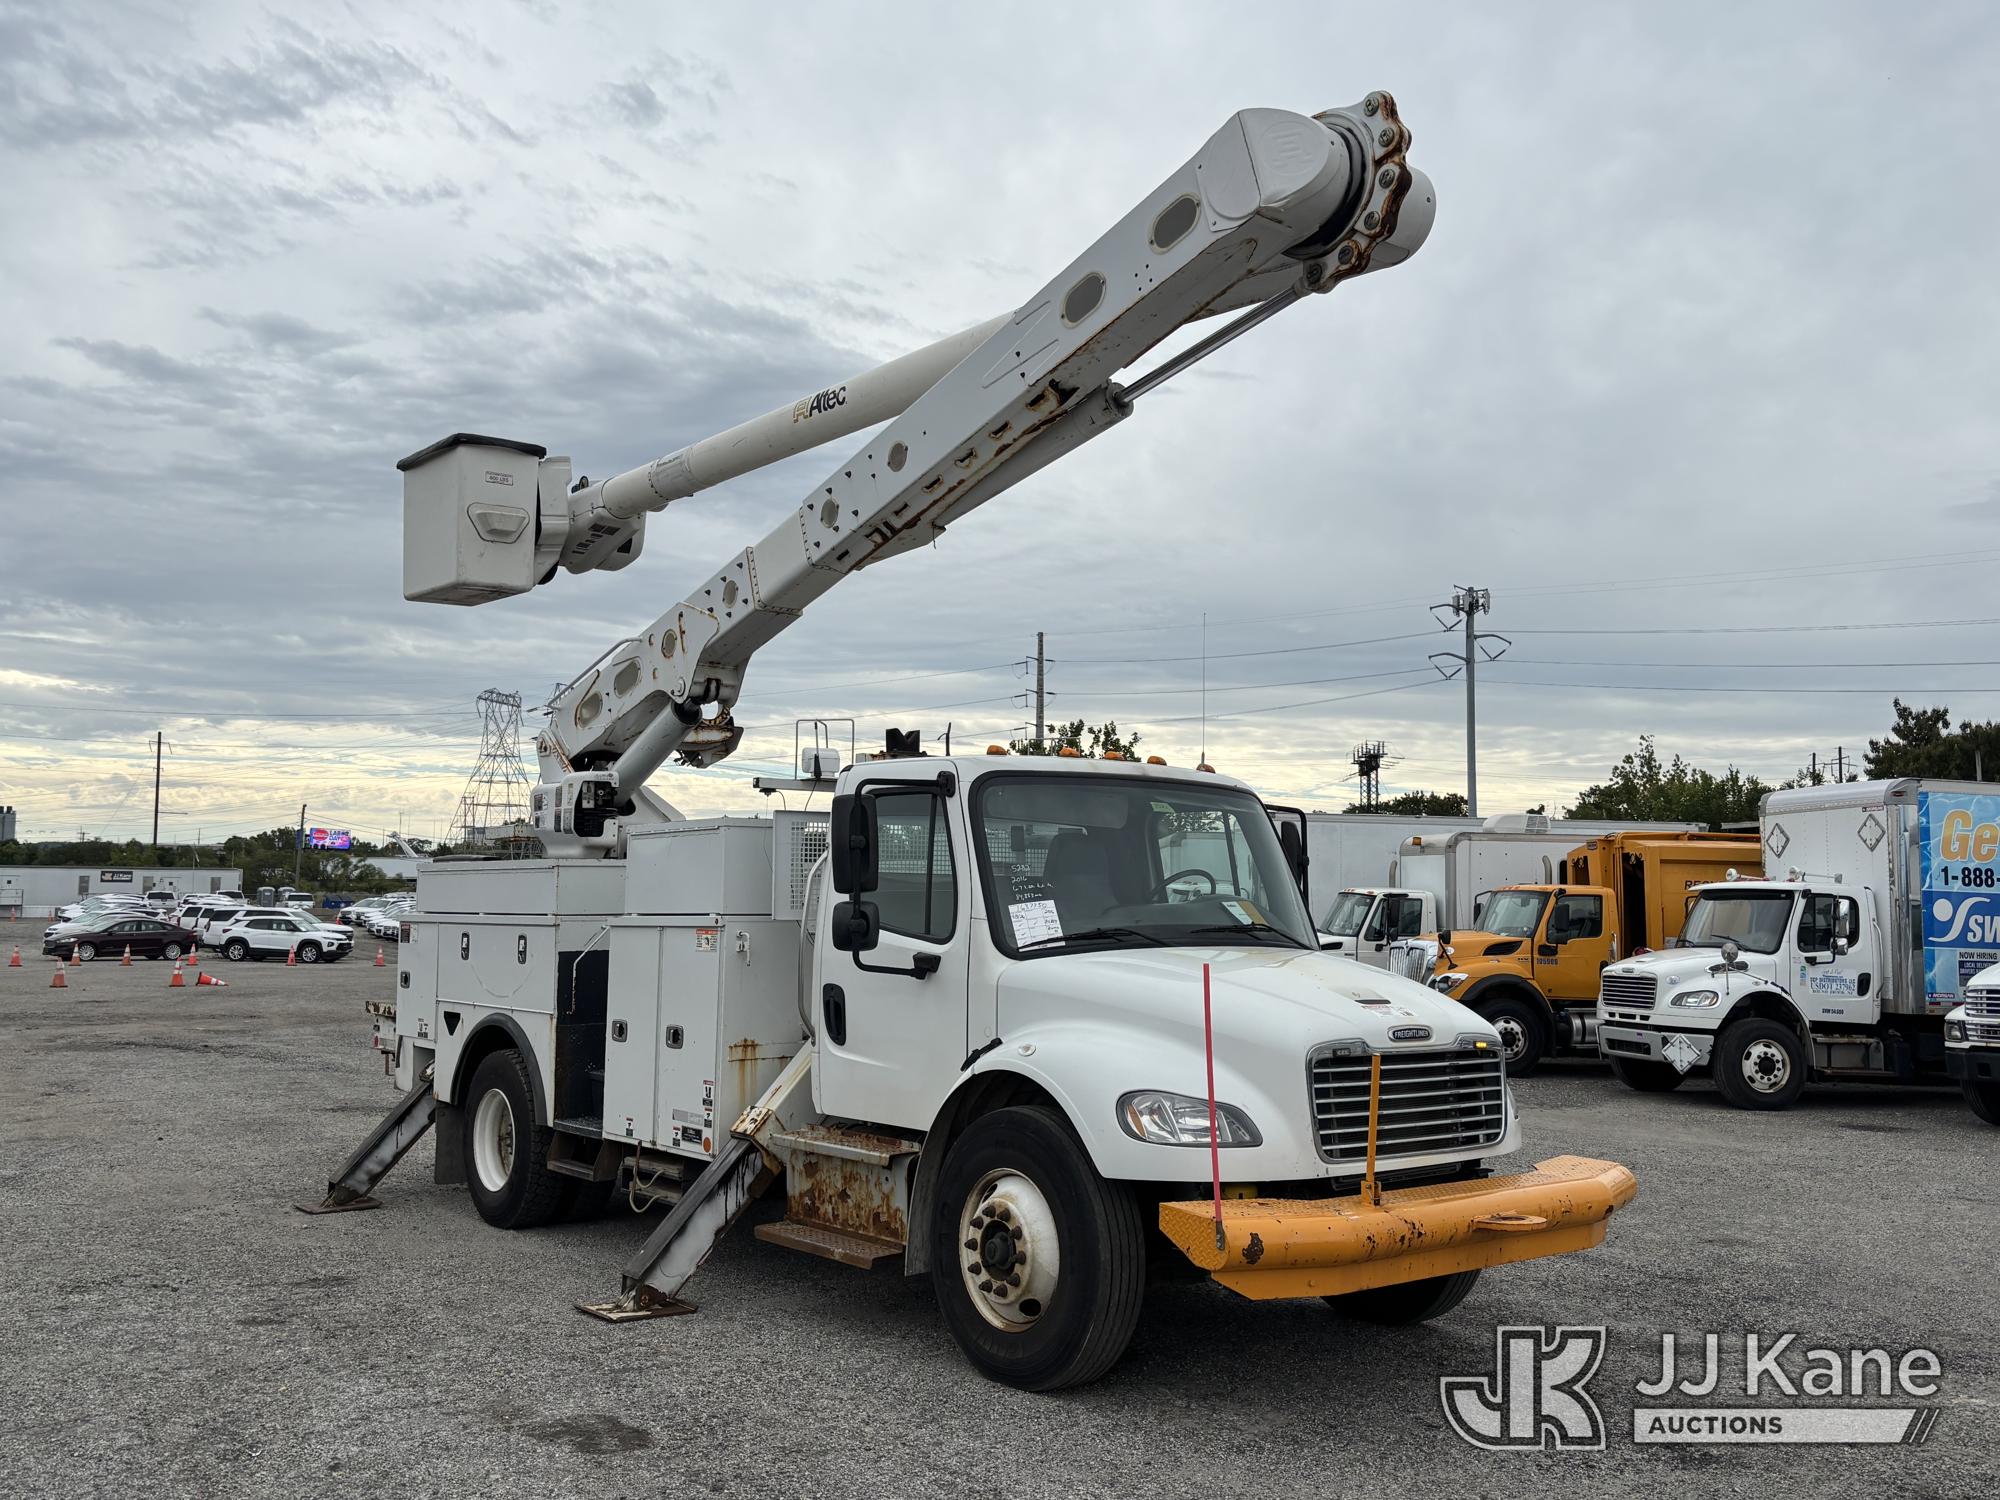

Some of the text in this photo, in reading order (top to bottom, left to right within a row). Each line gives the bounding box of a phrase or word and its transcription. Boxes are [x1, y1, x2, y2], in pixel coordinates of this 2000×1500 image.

[809, 386, 846, 417] Altec
[1959, 951, 1998, 960] NOW HIRING
[1810, 982, 1833, 990] USDOT
[1394, 1029, 1430, 1038] FREIGHTLINER
